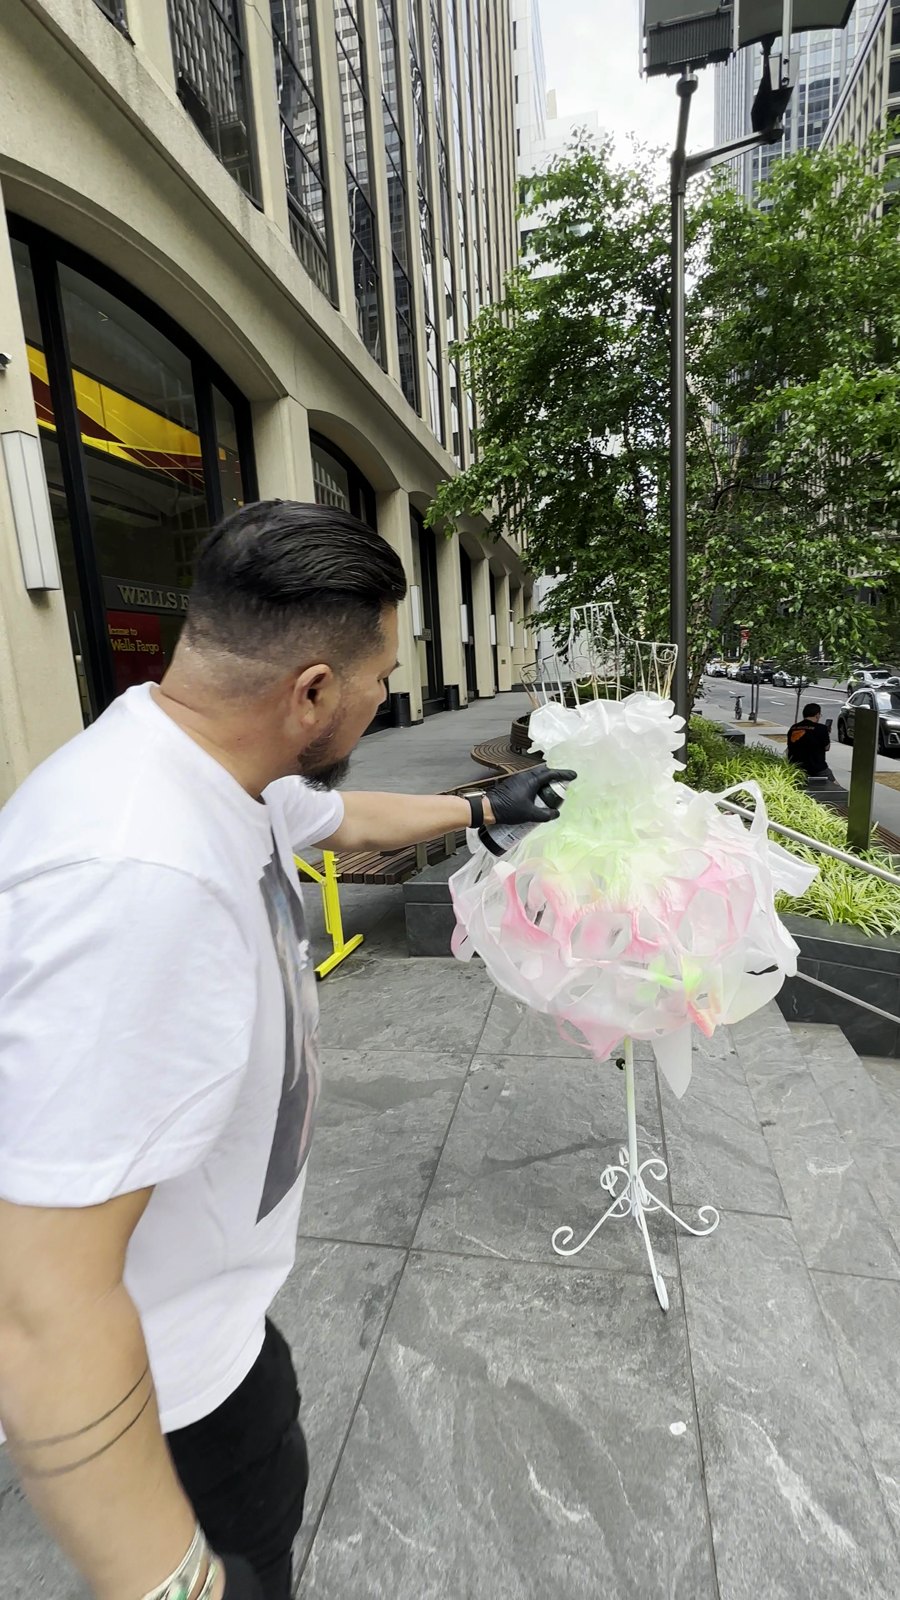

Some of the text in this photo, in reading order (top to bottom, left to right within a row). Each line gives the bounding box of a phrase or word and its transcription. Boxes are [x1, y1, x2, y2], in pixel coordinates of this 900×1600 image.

[117, 585, 178, 610] WELLS
[110, 638, 159, 655] Wells Fargo
